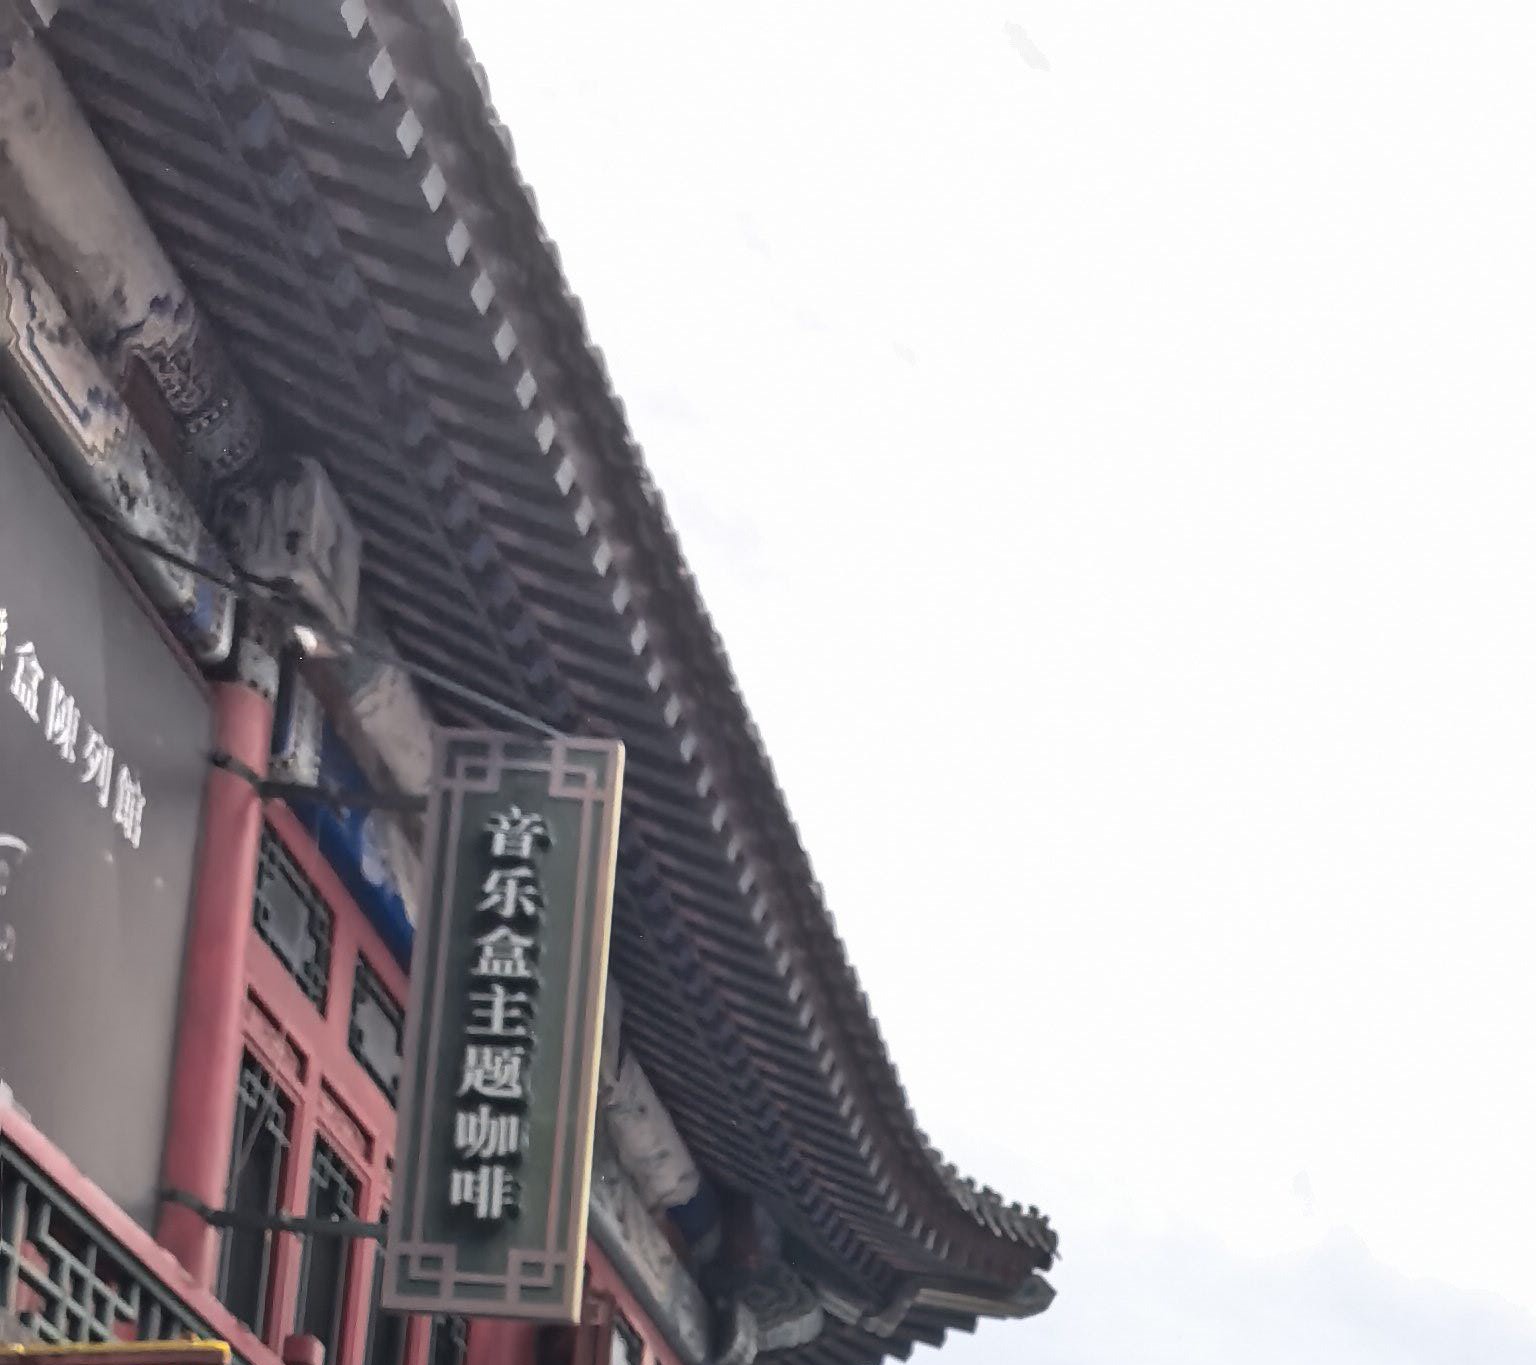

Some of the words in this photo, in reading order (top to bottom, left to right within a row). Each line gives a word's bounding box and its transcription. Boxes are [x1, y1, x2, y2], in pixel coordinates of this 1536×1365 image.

[0, 606, 147, 848] 盒陳列館
[450, 806, 549, 1220] 音乐盒主题咖啡
